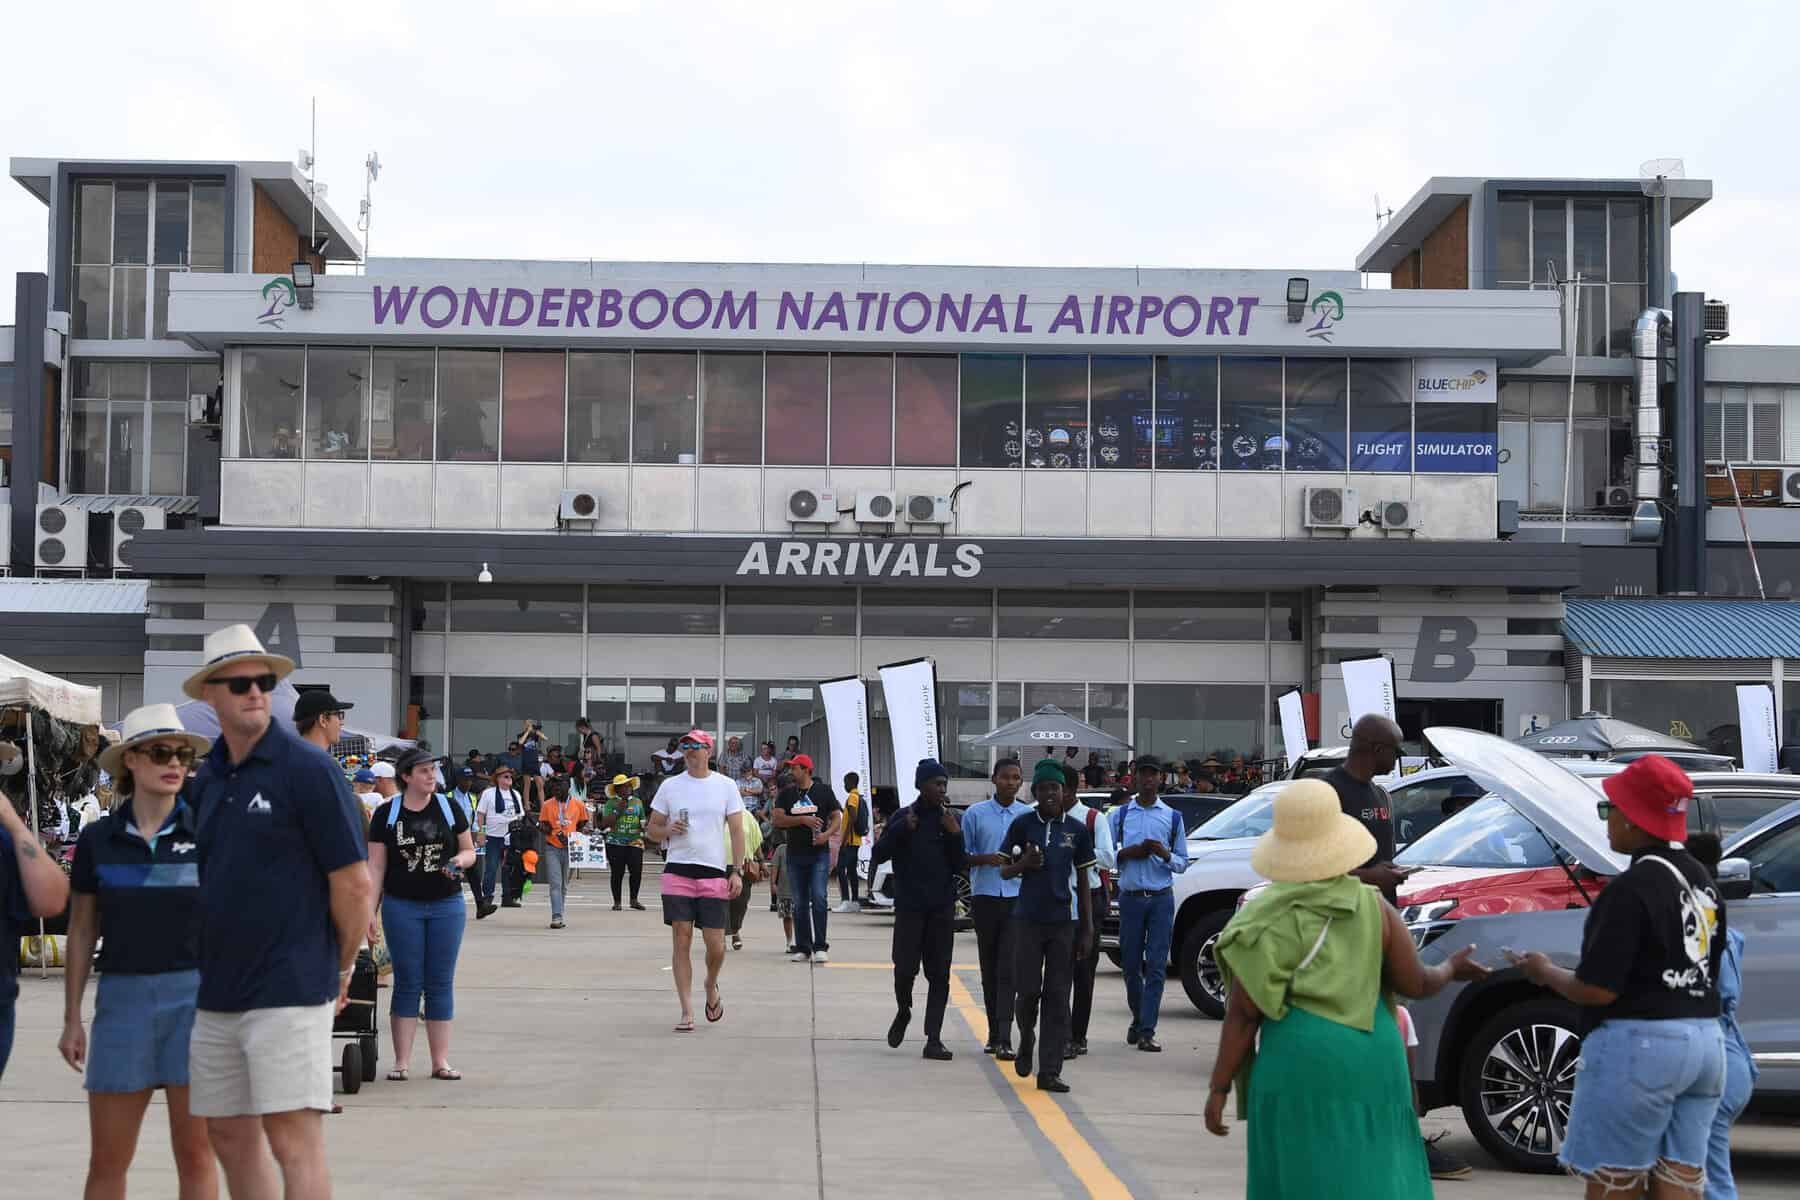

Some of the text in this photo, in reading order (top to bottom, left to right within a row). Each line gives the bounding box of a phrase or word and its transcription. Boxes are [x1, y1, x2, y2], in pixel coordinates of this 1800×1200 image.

[372, 285, 1260, 338] WONDERBOOM NATIONAL AIRPORT
[1418, 378, 1476, 390] BLUECHIP
[1356, 443, 1493, 456] FLIGHT SIMULATOR
[736, 541, 985, 578] ARRIVALS
[255, 602, 304, 669] A
[1409, 615, 1478, 682] B
